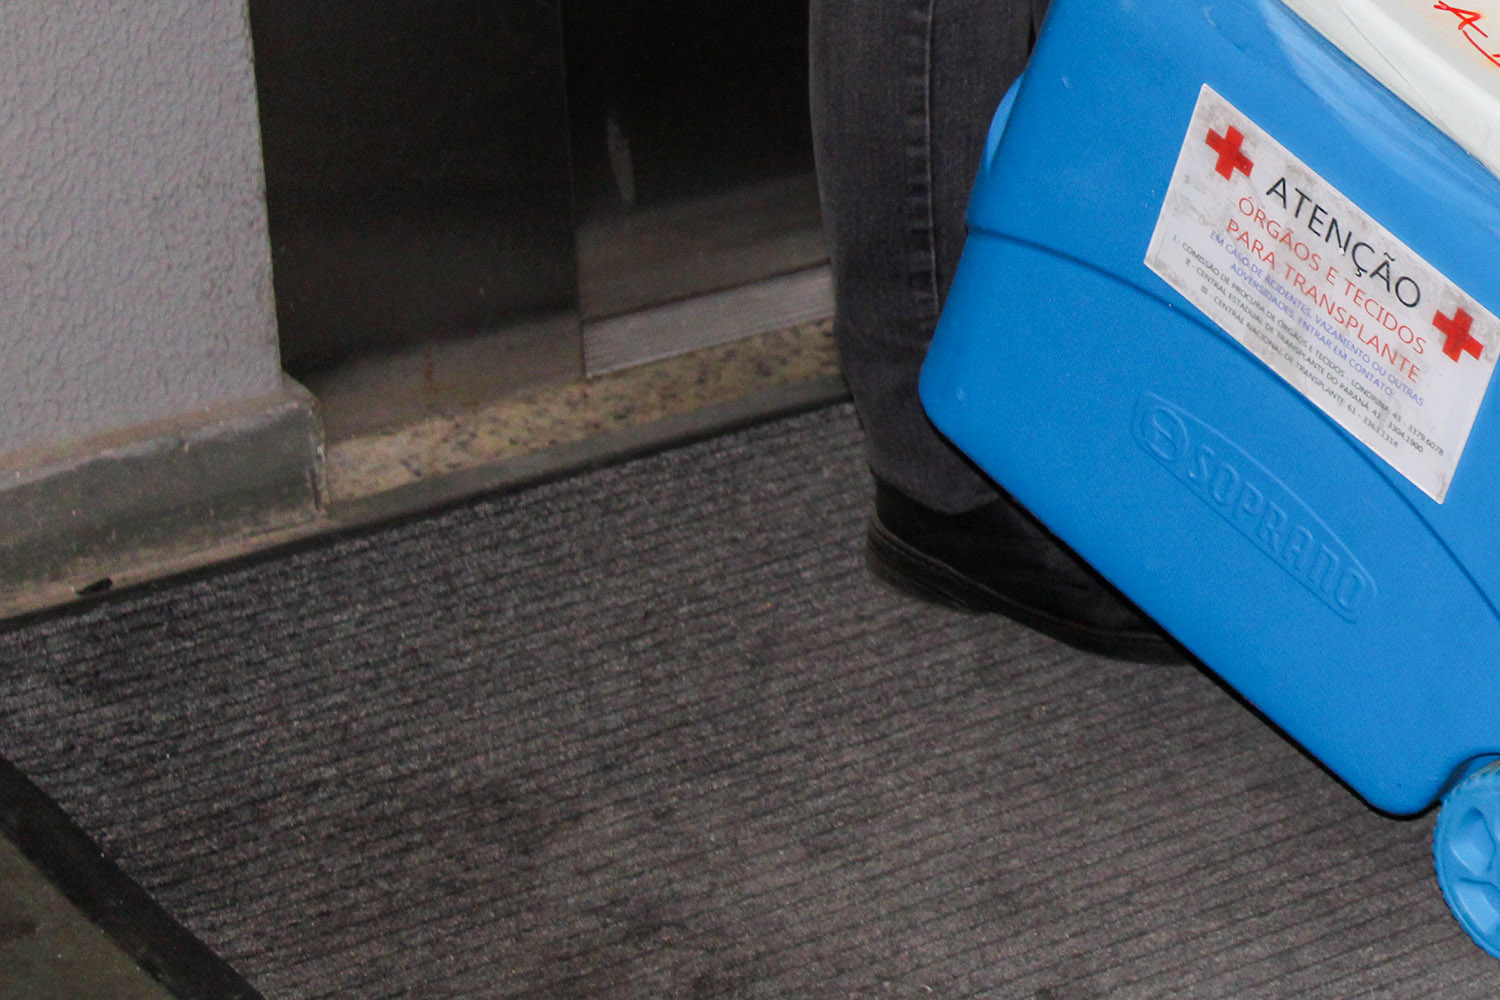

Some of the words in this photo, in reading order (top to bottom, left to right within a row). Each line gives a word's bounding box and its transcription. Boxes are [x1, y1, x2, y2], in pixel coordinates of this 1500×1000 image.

[1182, 242, 1220, 275] COMISSÃO
[1220, 273, 1230, 285] DE
[1231, 282, 1265, 313] PROCURA
[1265, 310, 1275, 322] DE
[1277, 319, 1307, 347] ÓRGÃOS
[1315, 349, 1344, 377] TECIDOS
[1226, 217, 1275, 270] PARA
[1284, 261, 1420, 383] TRANSPLANTE
[1238, 196, 1321, 271] ÓRGÃOS
[1325, 265, 1338, 285] E
[1344, 277, 1425, 354] TECIDOS
[1265, 176, 1420, 308] ATENÇÃO
[1195, 266, 1226, 295] CENTRAL
[1228, 292, 1262, 324] ESTADUAL
[1264, 322, 1274, 333] DE
[1276, 331, 1324, 373] TRANSPLANTE
[1326, 371, 1338, 385] DO
[1210, 230, 1224, 246] EM
[1249, 263, 1263, 278] DE
[1315, 315, 1370, 363] VAZAMENTO
[1371, 361, 1387, 376] OU
[1387, 373, 1423, 406] OUTRAS
[1213, 296, 1244, 324] CENTRAL
[1246, 322, 1281, 354] NACIONAL
[1283, 352, 1293, 364] DE
[1297, 316, 1332, 348] ENTRAR
[1332, 345, 1347, 360] EM
[1188, 443, 1367, 613] SOPRANO
